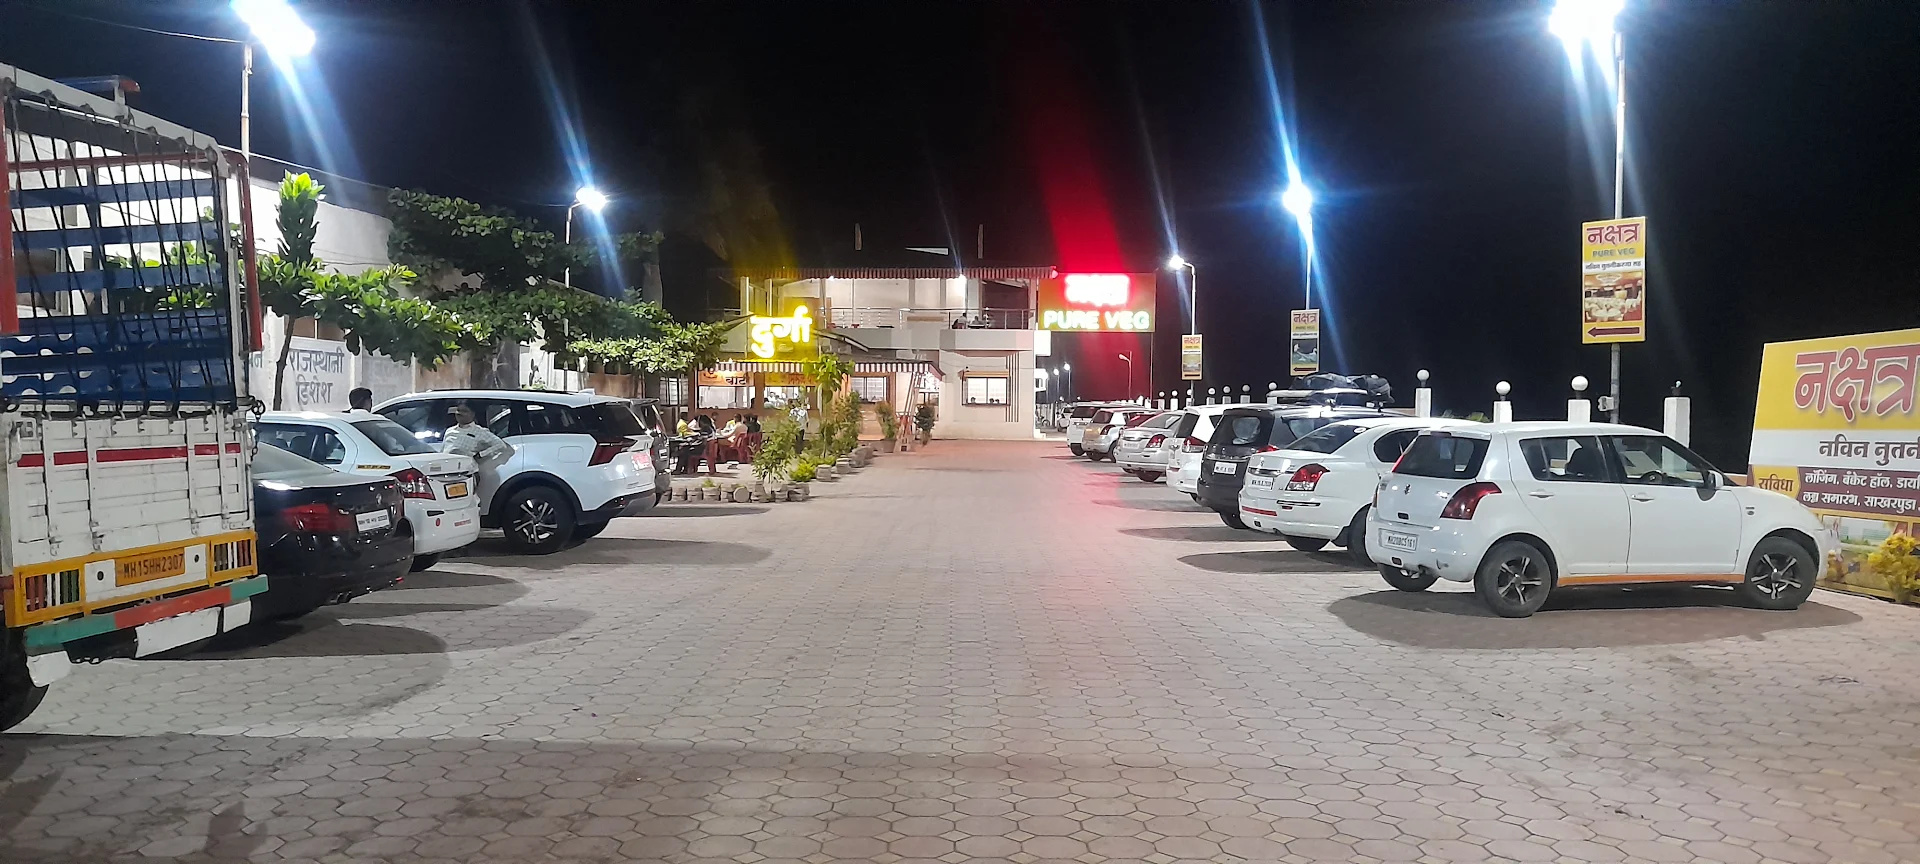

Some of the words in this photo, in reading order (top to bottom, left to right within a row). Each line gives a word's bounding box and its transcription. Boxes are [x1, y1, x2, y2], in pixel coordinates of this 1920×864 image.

[1586, 223, 1641, 245] नक्षत्र
[1592, 249, 1615, 258] PURE
[1617, 247, 1635, 255] VEG
[1043, 310, 1100, 329] PURE
[1104, 310, 1150, 329] VEG
[1293, 312, 1317, 324] नक्षत्र
[750, 305, 812, 358] दुर्गा
[289, 346, 345, 373] राजस्थानी
[296, 375, 333, 405] डिशेश
[1794, 343, 1920, 423] नक्षत्र
[1819, 434, 1870, 458] नविन
[1875, 437, 1920, 466] नुतन
[123, 553, 184, 579] MH15HH2307
